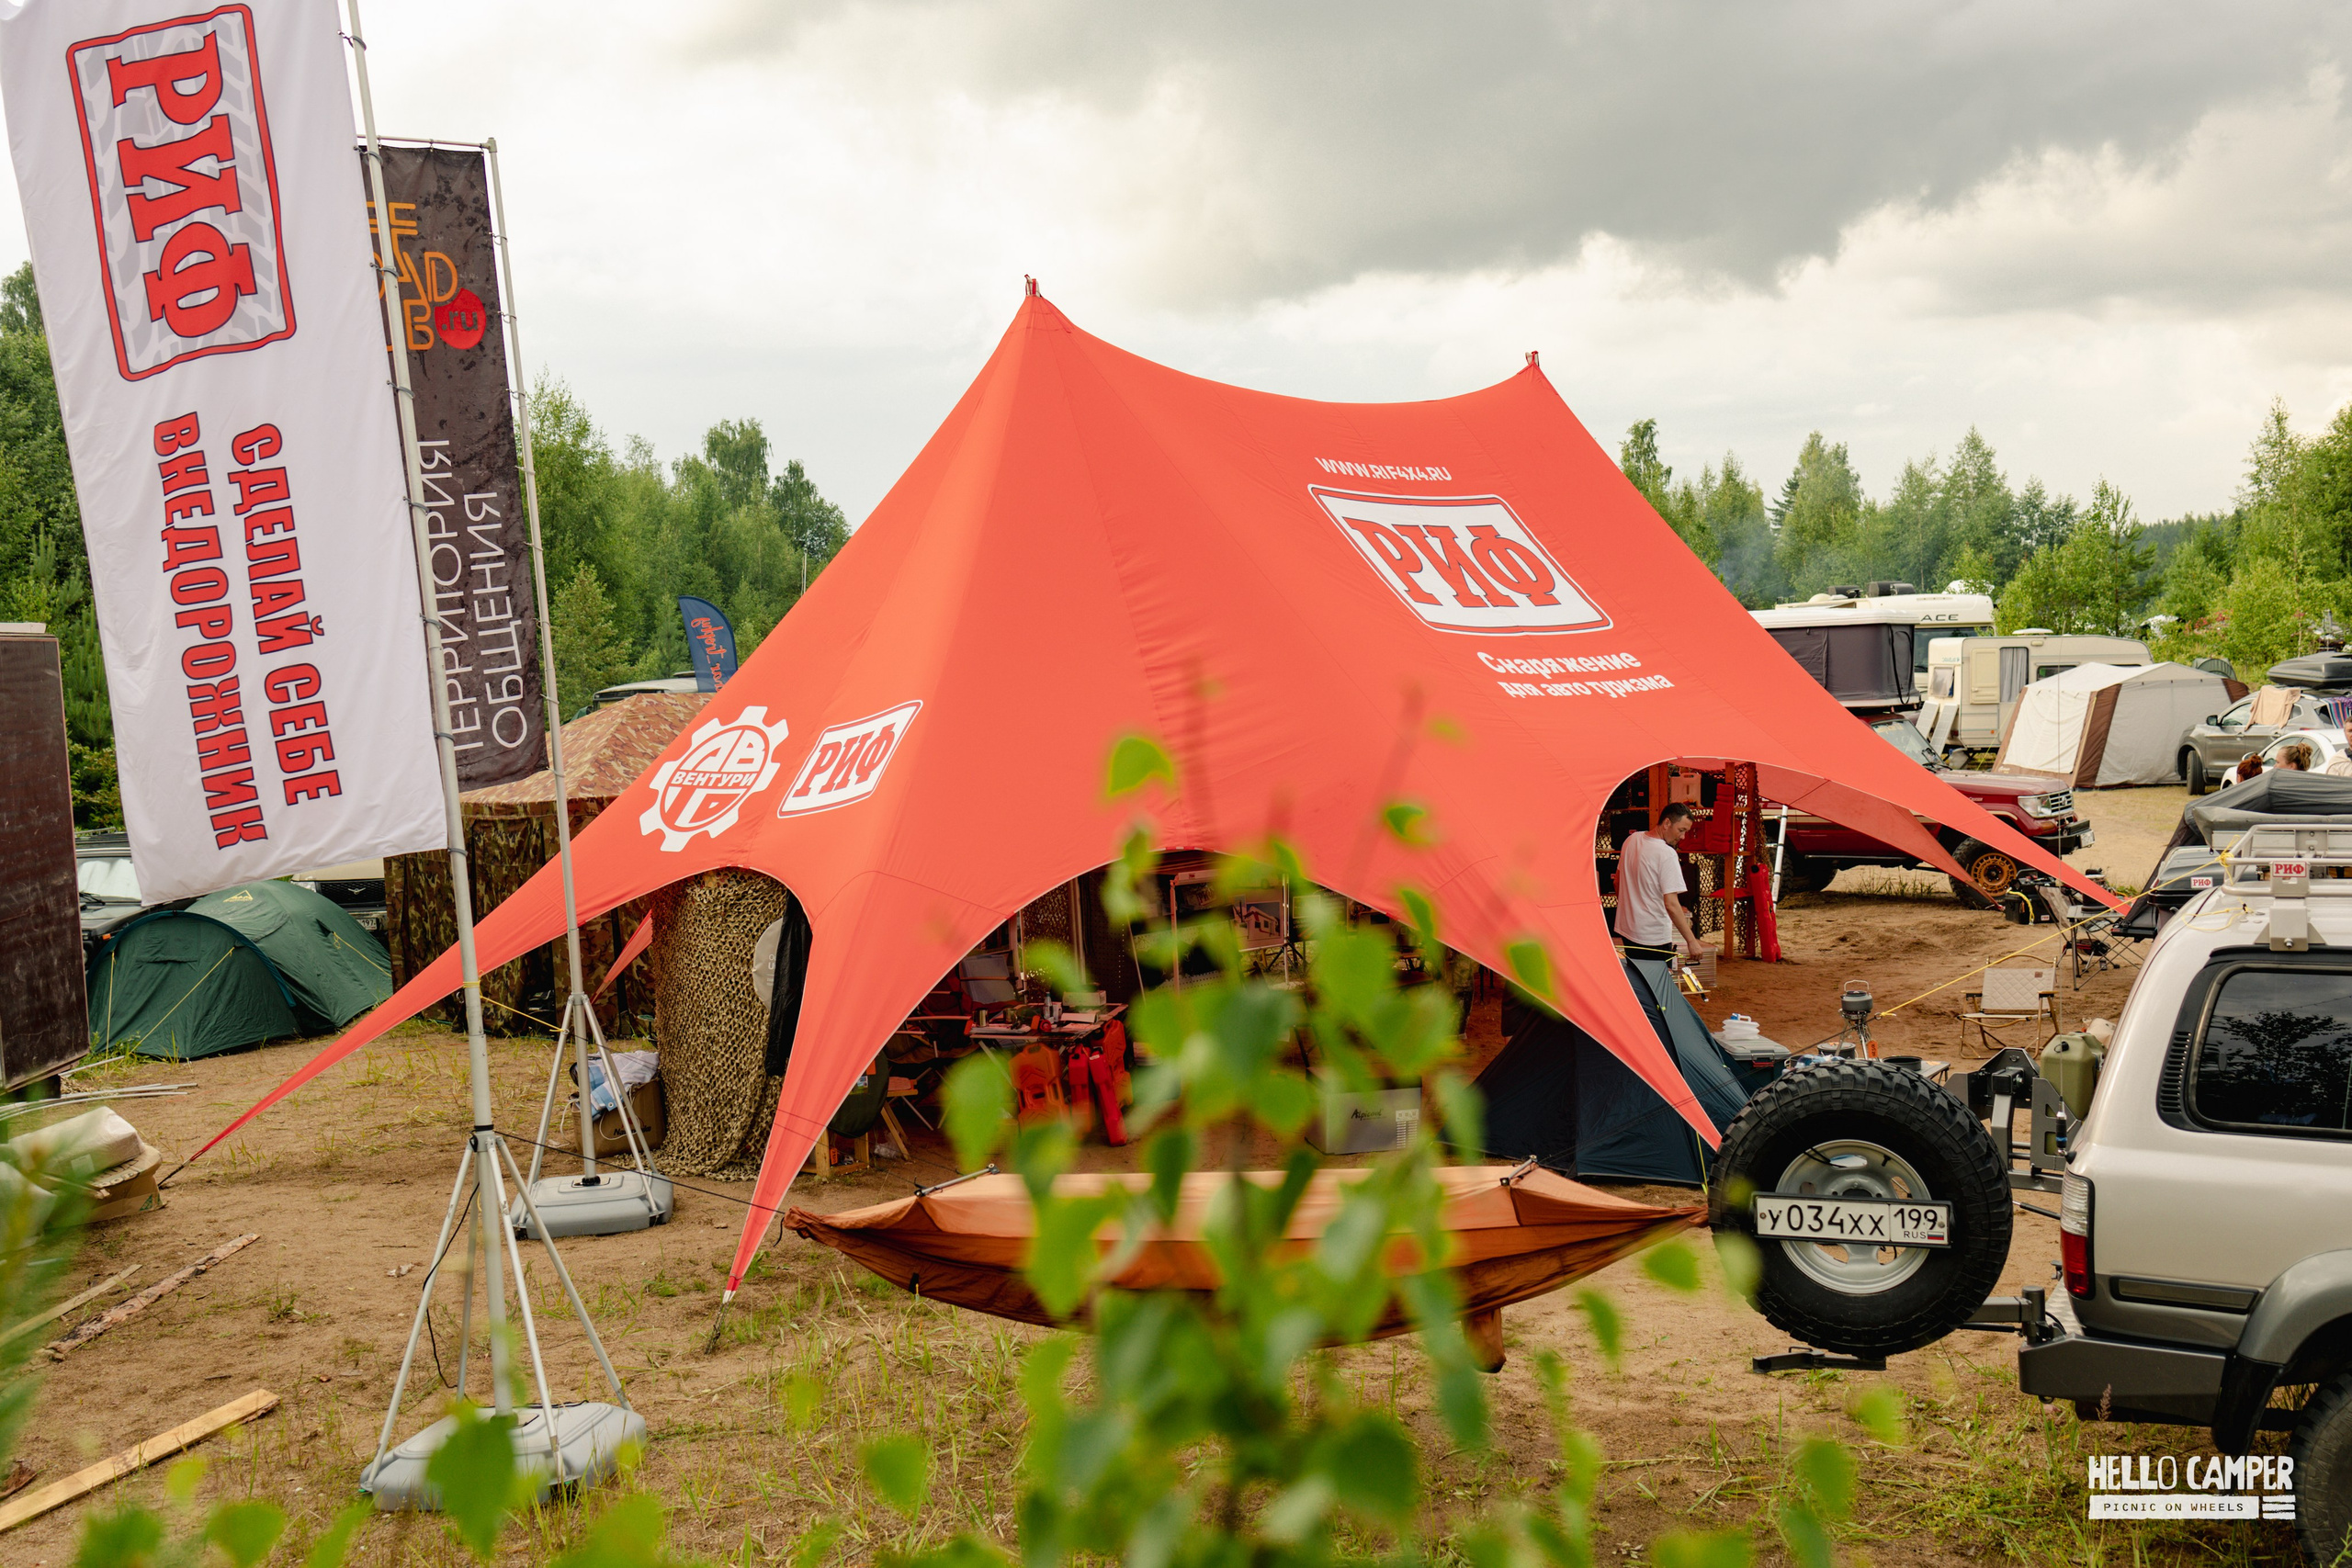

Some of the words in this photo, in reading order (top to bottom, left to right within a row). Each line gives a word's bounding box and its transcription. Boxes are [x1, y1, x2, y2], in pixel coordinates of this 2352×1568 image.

[106, 30, 258, 338] РИФ
[441, 310, 479, 331] .ru
[1314, 457, 1453, 481] WWW.RIF4X4.RU
[228, 423, 324, 655] СДЕЛАЙ
[1341, 515, 1562, 608] РИФ
[153, 411, 269, 851] ВНЕДОРОЖНИК
[463, 491, 528, 750] ОБЩЕНИЯ
[1476, 651, 1642, 680] Снаряжение
[1497, 681, 1545, 699] для
[264, 662, 343, 806] СЕБЕ
[792, 722, 897, 798] РИФ
[671, 771, 758, 787] ВЕНТУРИ
[2275, 863, 2304, 874] РИФ
[1894, 1208, 1938, 1231] 199
[1904, 1231, 1926, 1239] RUS
